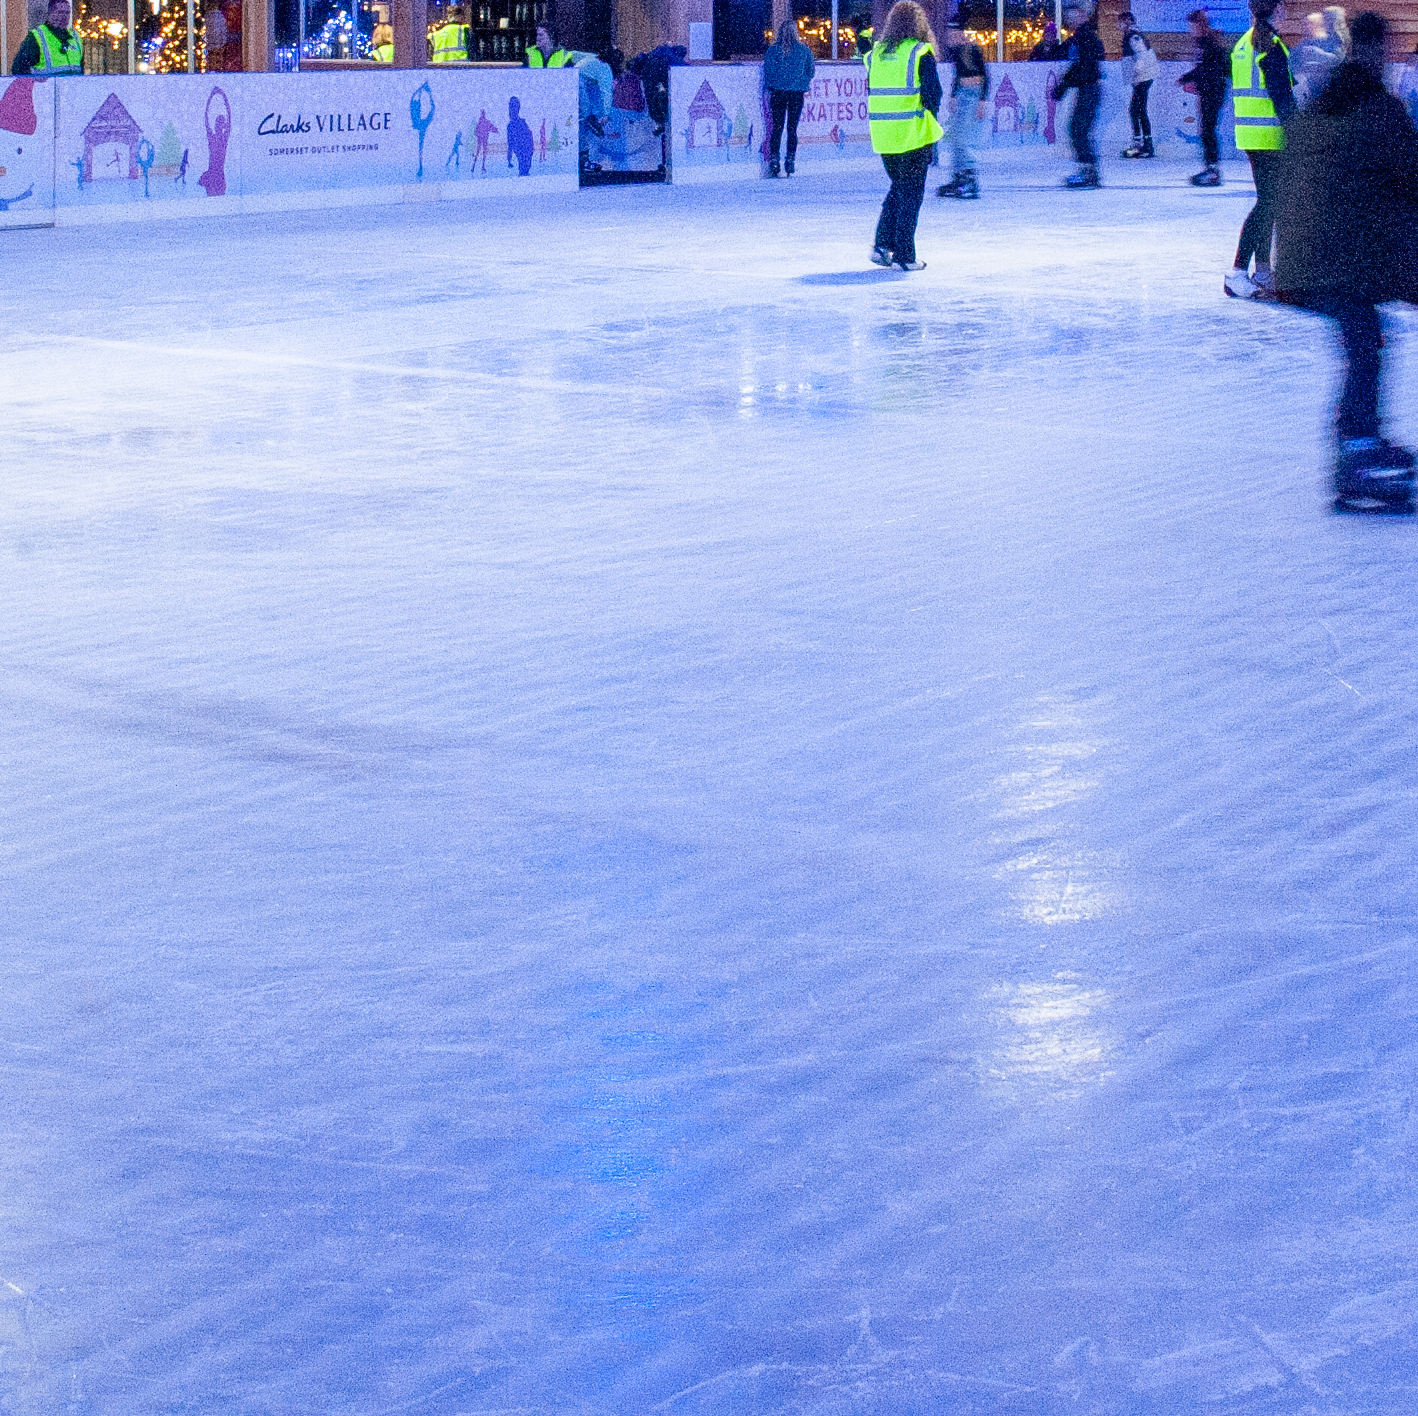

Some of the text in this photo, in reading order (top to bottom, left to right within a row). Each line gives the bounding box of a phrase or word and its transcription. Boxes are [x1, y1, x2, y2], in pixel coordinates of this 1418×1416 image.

[809, 78, 831, 97] ET
[257, 112, 392, 136] Clarks VILLAGE
[268, 143, 379, 156] SOMERSET OUTLET SHOPPING
